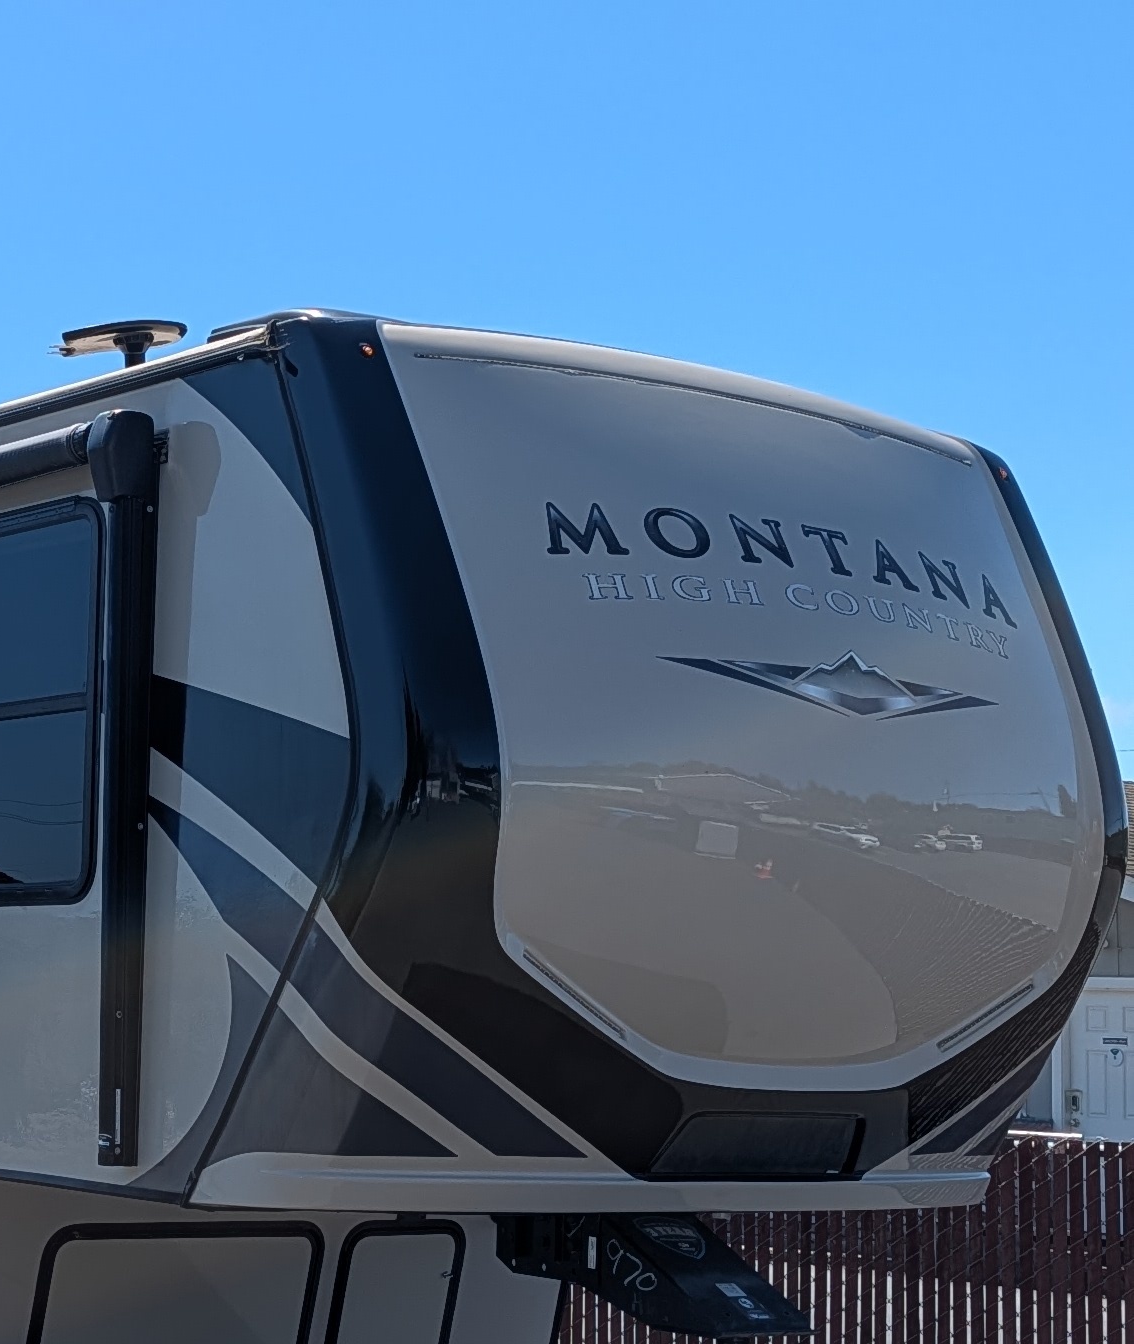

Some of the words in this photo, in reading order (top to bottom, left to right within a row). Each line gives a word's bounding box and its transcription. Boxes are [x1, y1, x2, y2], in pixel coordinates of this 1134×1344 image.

[545, 501, 1018, 629] MONTANA
[582, 571, 765, 606] HIGH
[785, 583, 1010, 660] COUNTRY
[606, 1238, 658, 1291] 970
